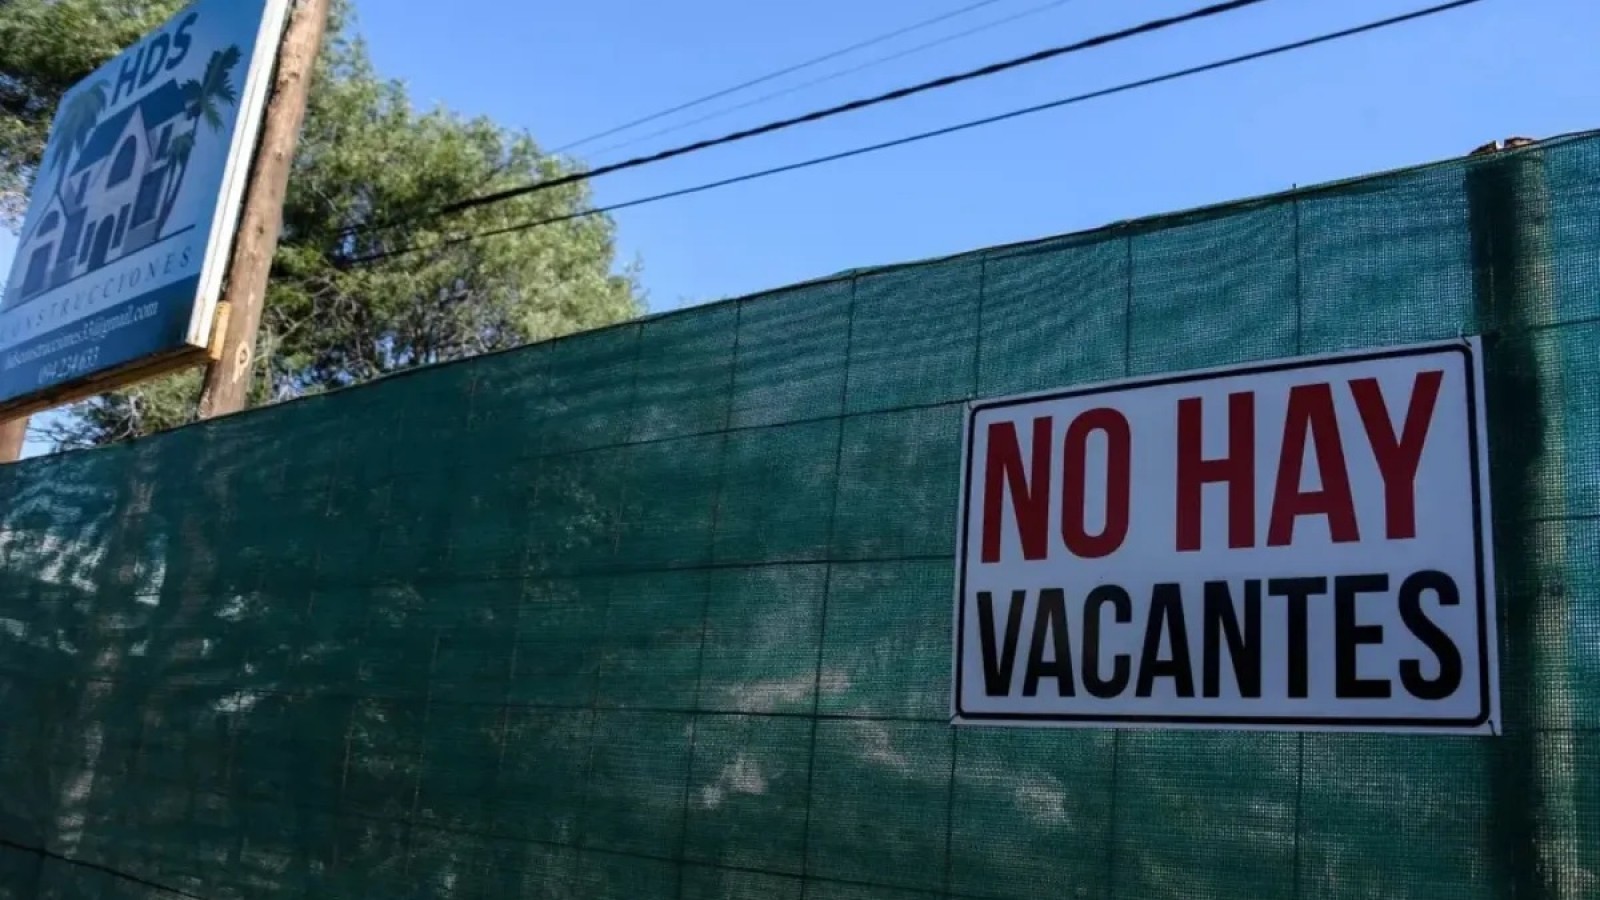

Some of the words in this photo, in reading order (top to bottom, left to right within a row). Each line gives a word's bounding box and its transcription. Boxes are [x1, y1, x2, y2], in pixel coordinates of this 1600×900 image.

[111, 12, 199, 105] HDS
[980, 407, 1132, 563] NO
[1176, 370, 1444, 552] HAY
[976, 570, 1463, 700] VACANTES
